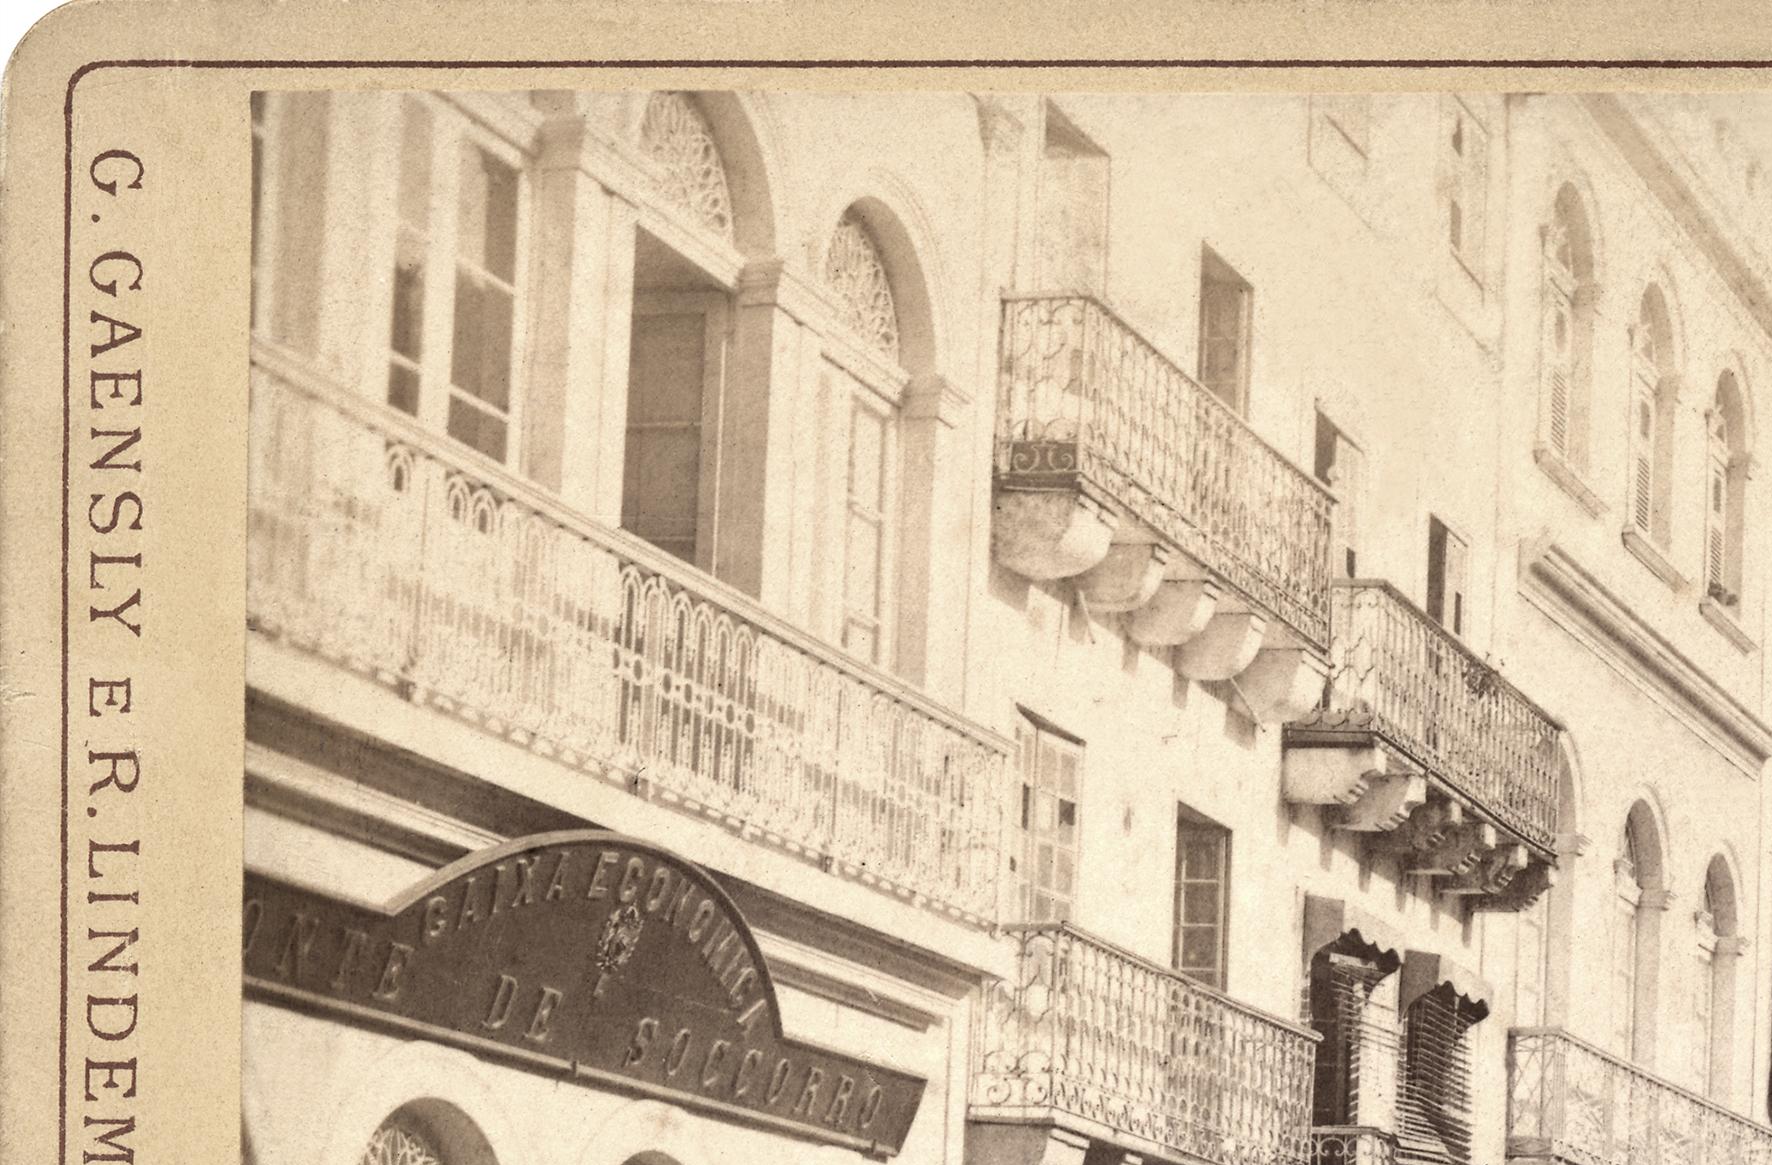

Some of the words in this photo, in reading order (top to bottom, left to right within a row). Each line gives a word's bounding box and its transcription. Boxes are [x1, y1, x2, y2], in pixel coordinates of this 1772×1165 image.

[423, 851, 571, 939] CAIXA
[482, 973, 563, 1043] DE
[622, 1017, 882, 1129] SOCCORRO
